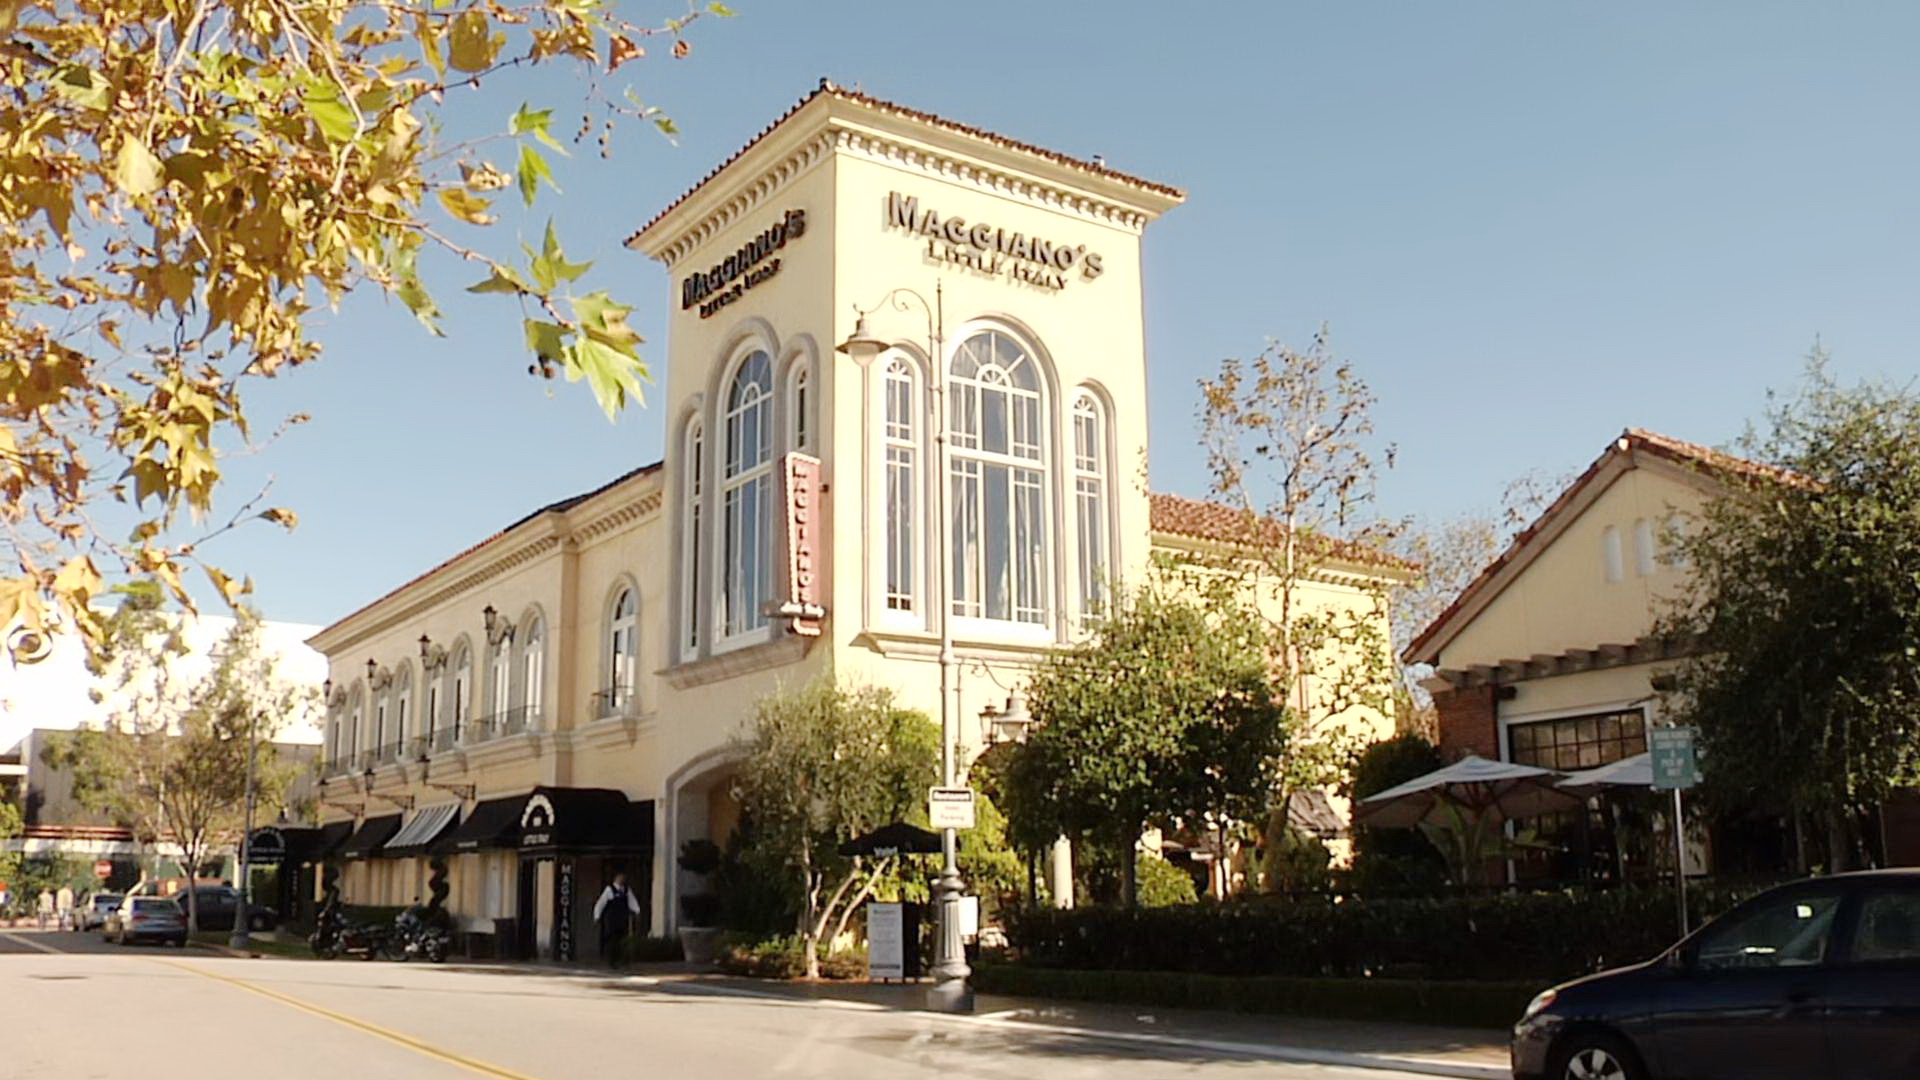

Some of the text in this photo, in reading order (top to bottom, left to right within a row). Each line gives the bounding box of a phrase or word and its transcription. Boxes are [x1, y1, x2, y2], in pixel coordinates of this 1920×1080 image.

[888, 190, 1103, 280] MAGGIANO'S
[928, 239, 1069, 291] LITTLE ITALY
